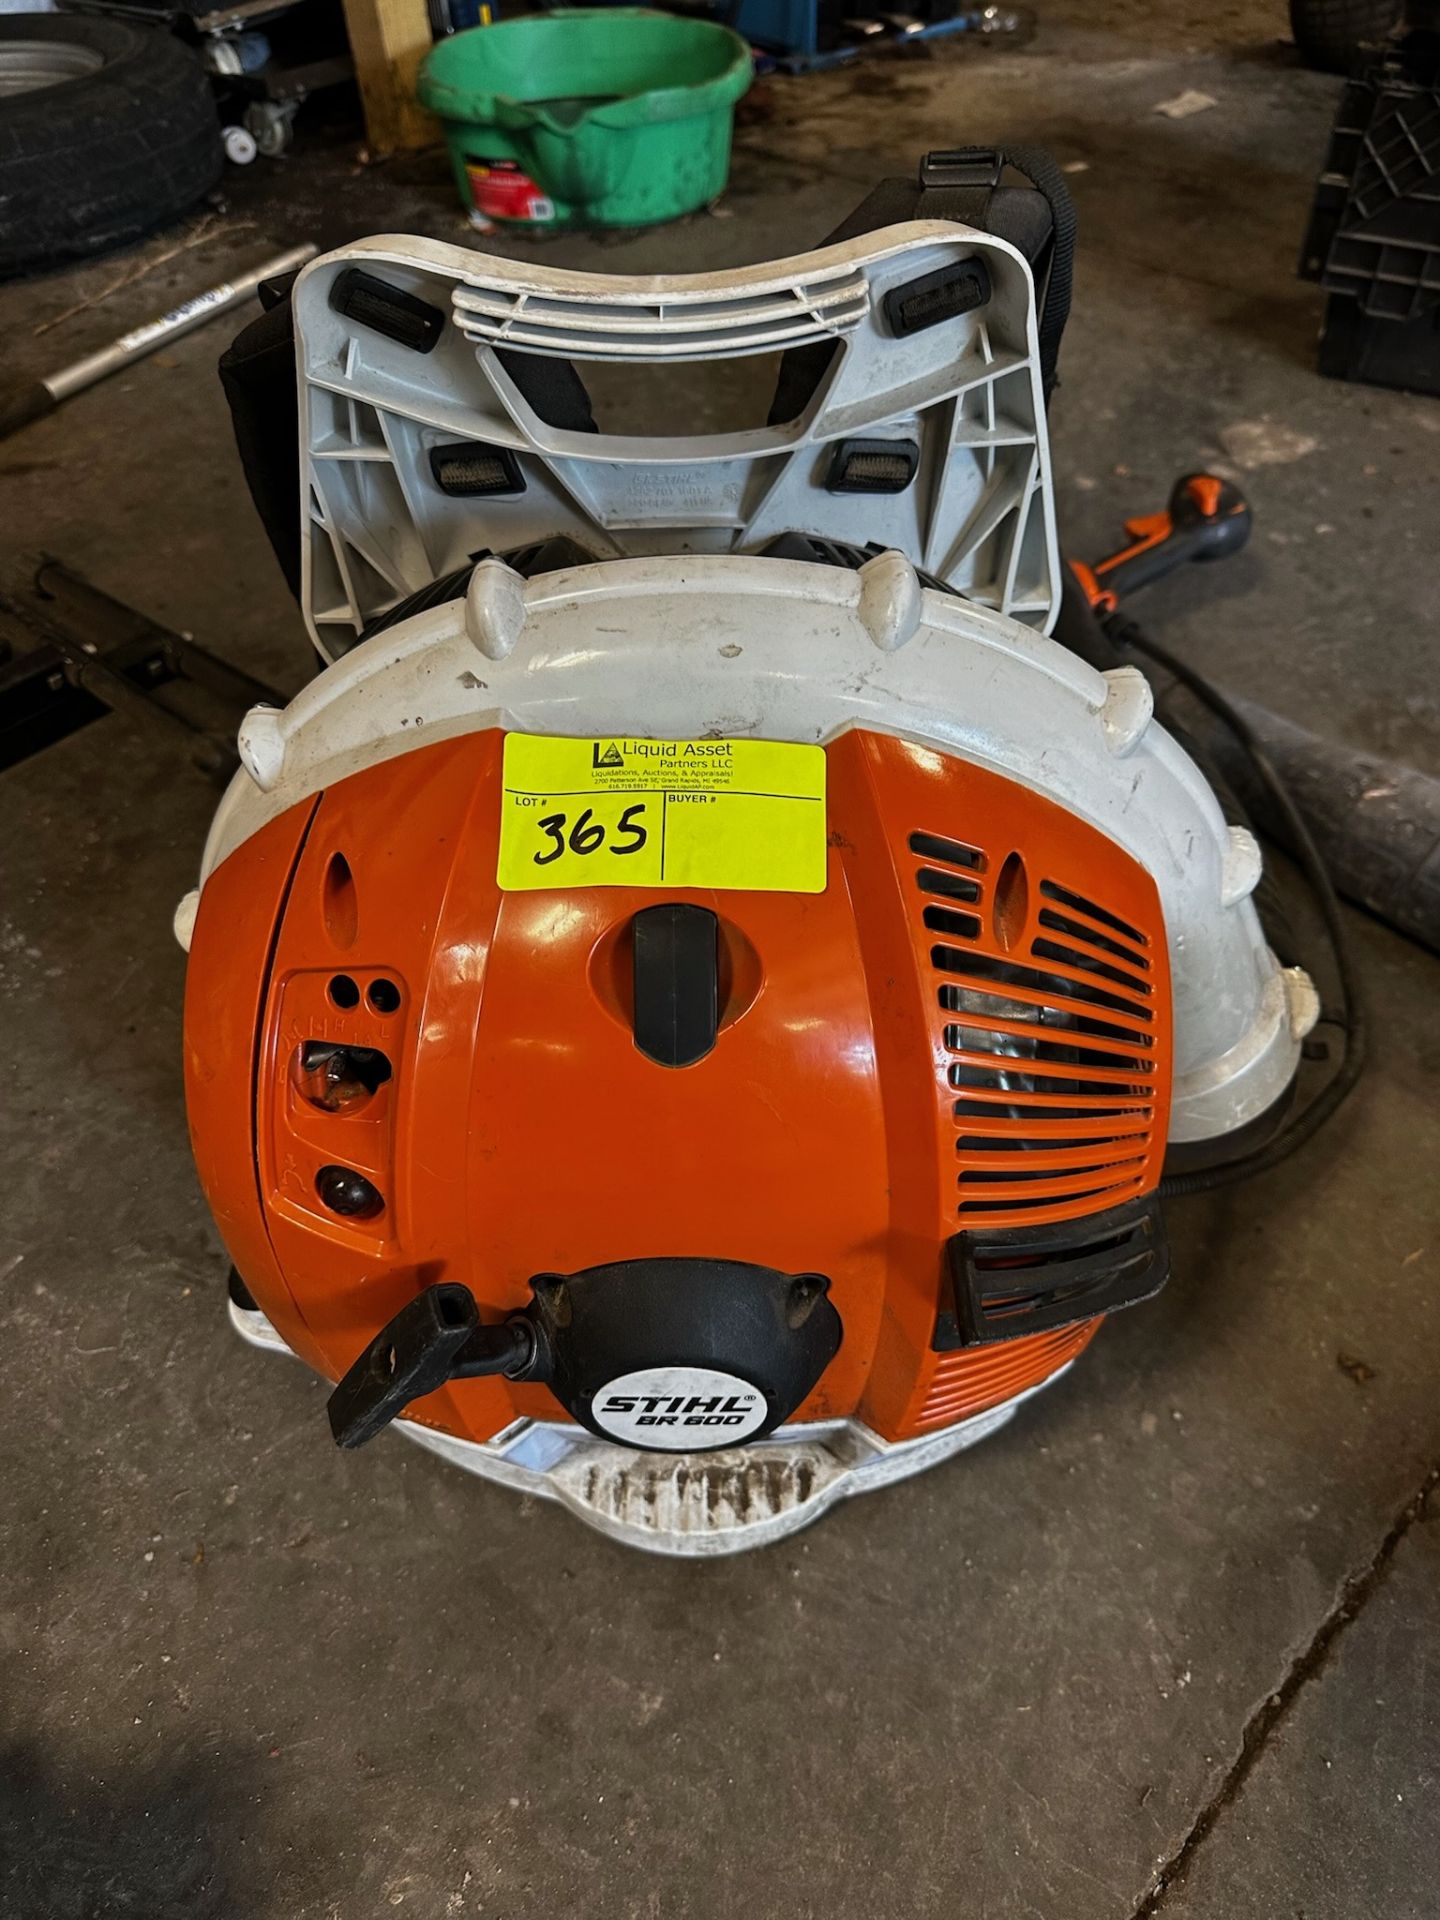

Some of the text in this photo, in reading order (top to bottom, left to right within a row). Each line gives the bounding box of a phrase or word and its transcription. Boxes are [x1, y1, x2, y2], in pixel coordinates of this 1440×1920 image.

[623, 741, 733, 758] Liquid Asset
[660, 759, 733, 768] Partners LLC
[591, 769, 640, 778] Liquidations,
[642, 769, 679, 778] Auctions,
[690, 769, 734, 778] Appraisals!
[515, 796, 548, 807] LOT #
[668, 794, 717, 804] BUYER #
[533, 803, 647, 866] 365
[634, 1415, 746, 1426] BR 600
